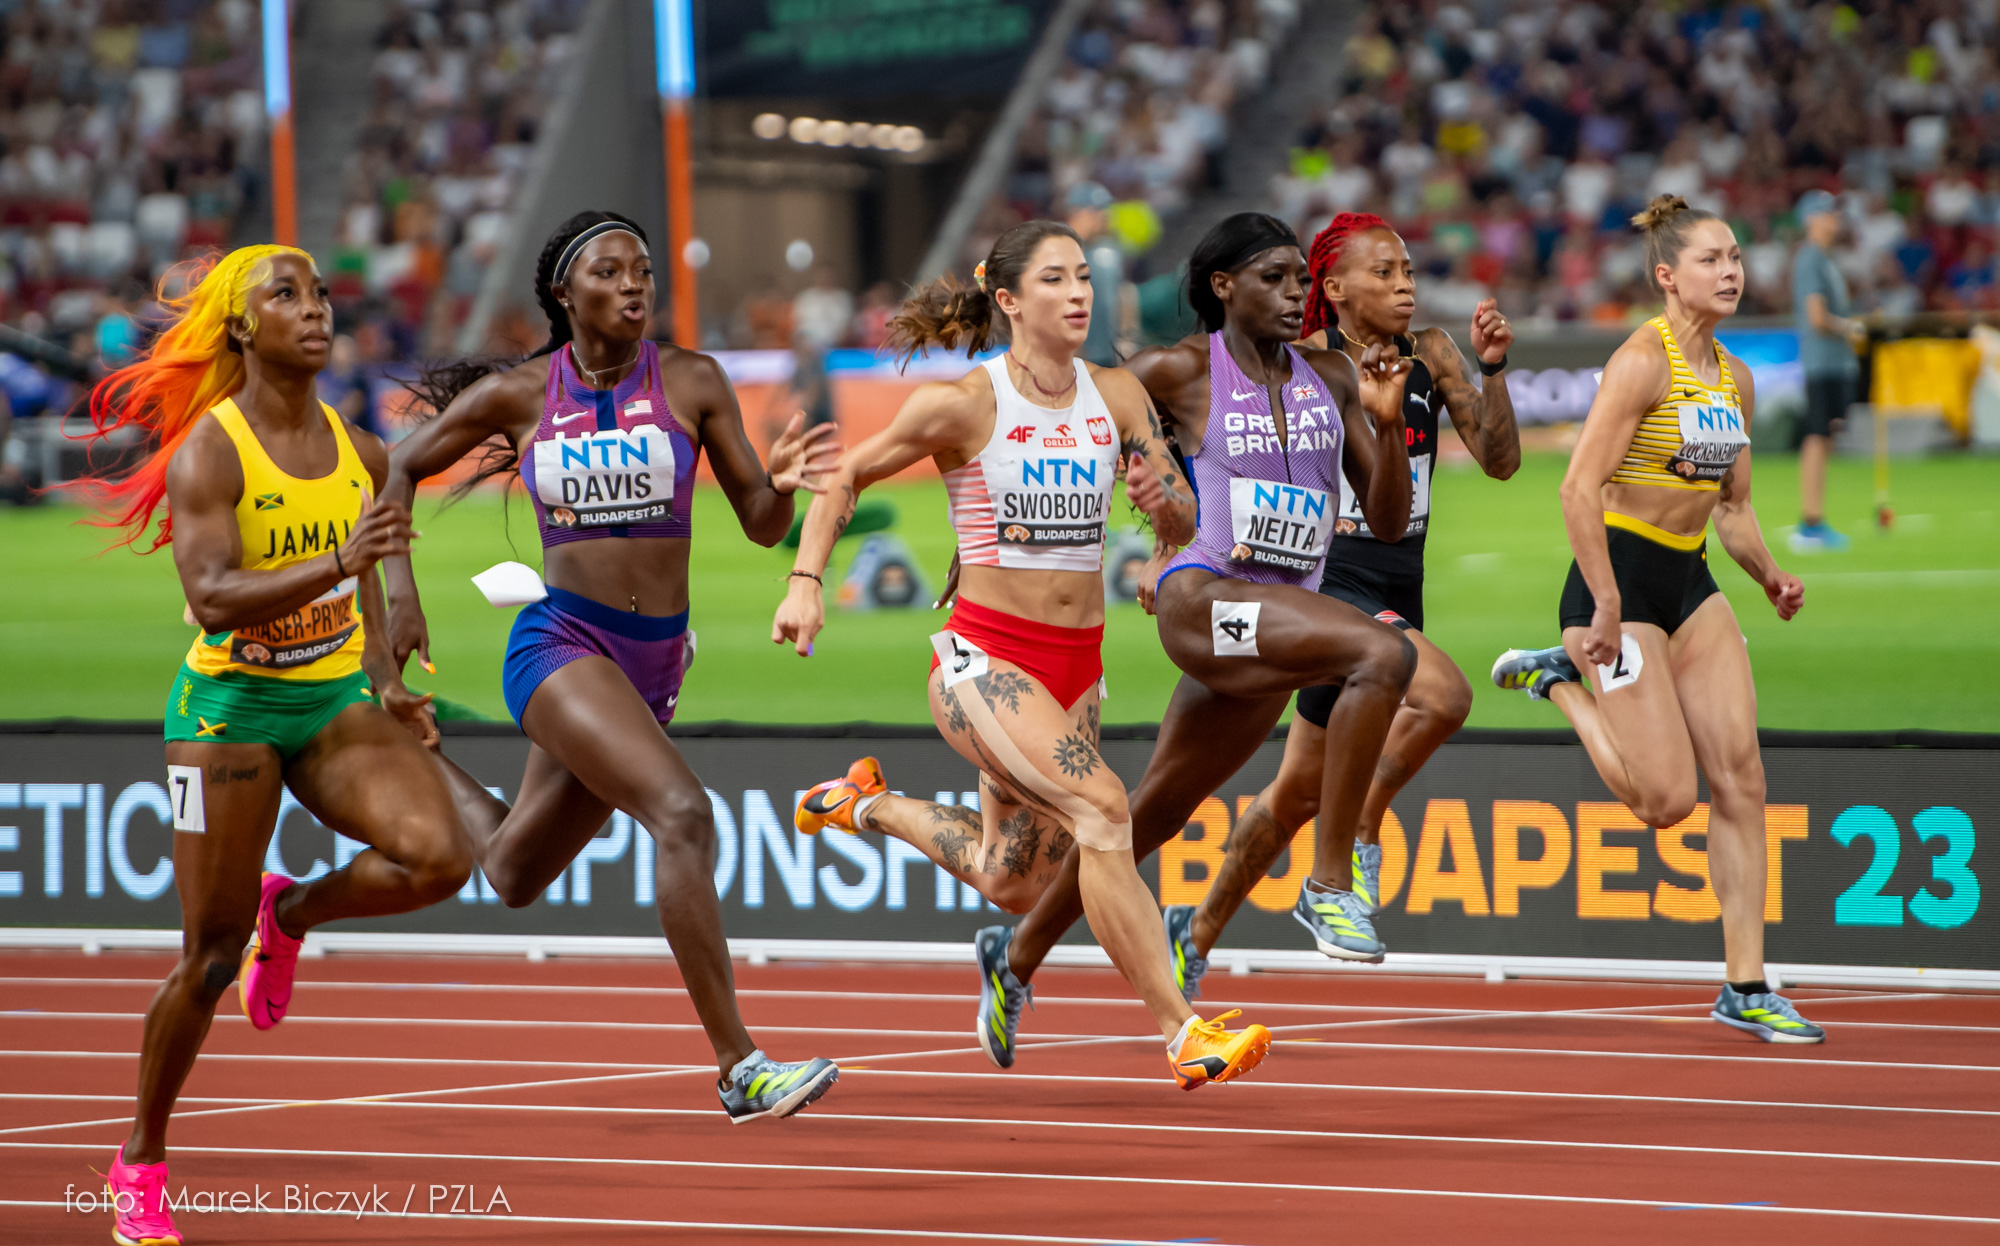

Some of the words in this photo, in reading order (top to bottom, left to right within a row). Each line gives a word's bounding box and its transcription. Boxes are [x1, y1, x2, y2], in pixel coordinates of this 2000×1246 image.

[1224, 406, 1330, 433] GREAT
[1697, 406, 1740, 431] NTN
[1006, 425, 1036, 443] 4F
[1045, 439, 1075, 447] ORLEN
[1226, 429, 1338, 457] BRITAIN
[561, 437, 649, 471] NTN
[1023, 458, 1096, 487] NTN
[562, 472, 652, 504] DAVIS
[1254, 482, 1326, 521] NTN
[581, 508, 650, 524] BUDAPEST
[651, 505, 665, 516] 23
[1003, 492, 1103, 519] SWOBODA
[1034, 529, 1089, 540] BUDAPEST
[1247, 514, 1317, 551] NEITA
[1254, 551, 1310, 570] BUDAPEST
[240, 594, 352, 643] RASER-PRYCE
[1219, 618, 1249, 642] 4
[175, 775, 188, 819] 7
[0, 782, 174, 900] ETIC
[1830, 805, 1981, 930] 23
